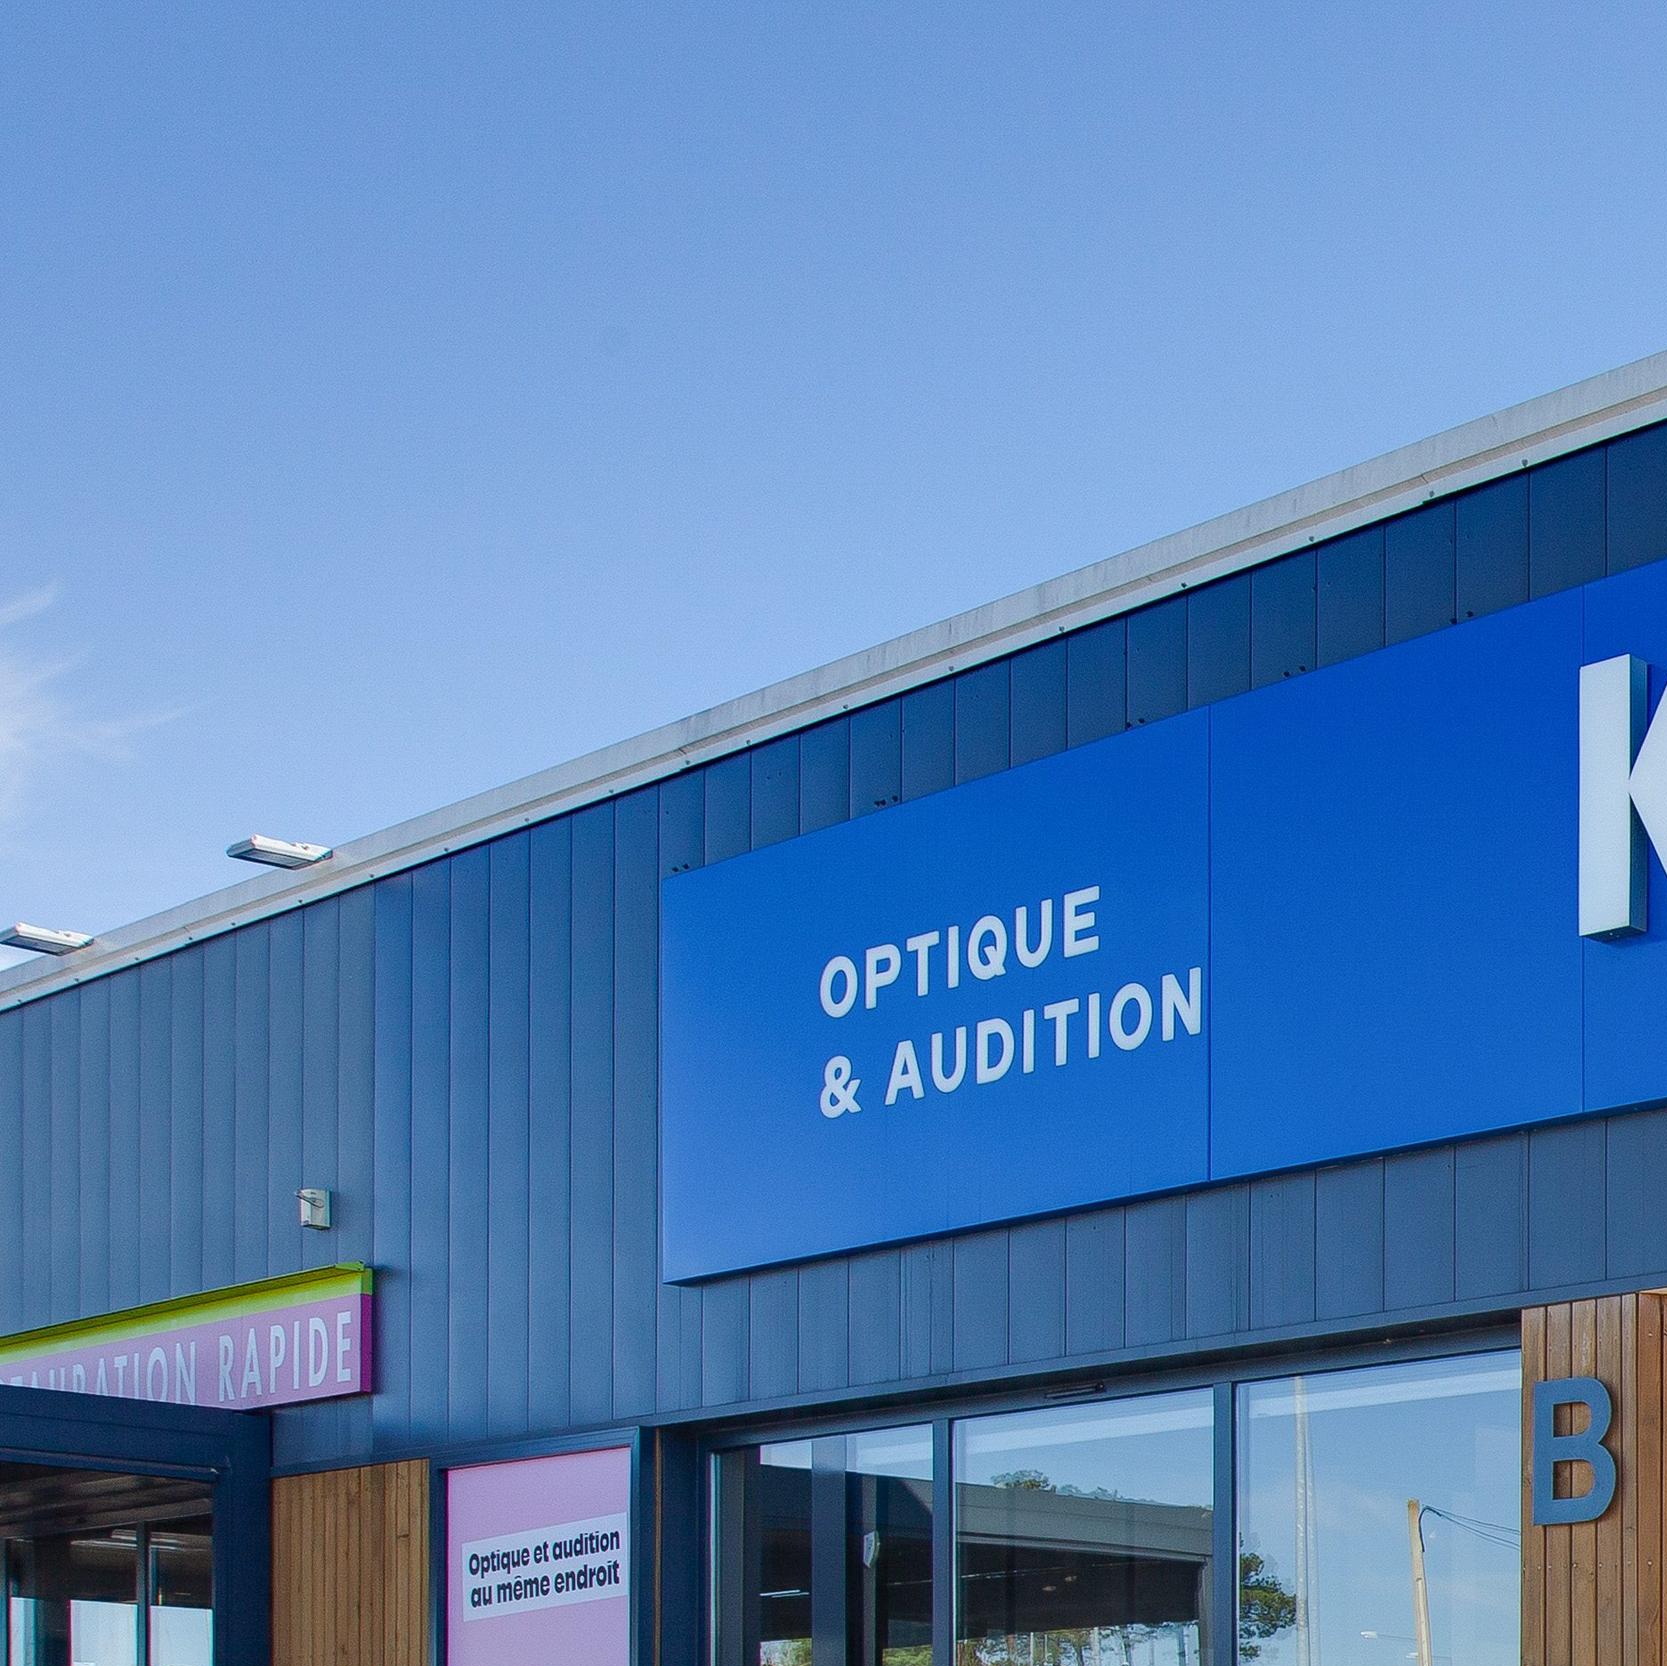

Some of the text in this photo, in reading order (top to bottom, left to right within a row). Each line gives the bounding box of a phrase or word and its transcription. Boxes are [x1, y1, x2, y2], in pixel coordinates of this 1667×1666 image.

[819, 885, 1101, 1019] OPTIQUE
[819, 967, 1203, 1118] & AUDITION
[218, 1311, 353, 1403] RAPIDE
[1532, 1377, 1617, 1527] B
[469, 1530, 620, 1579] Optique et audition
[471, 1560, 620, 1608] au même endroit
